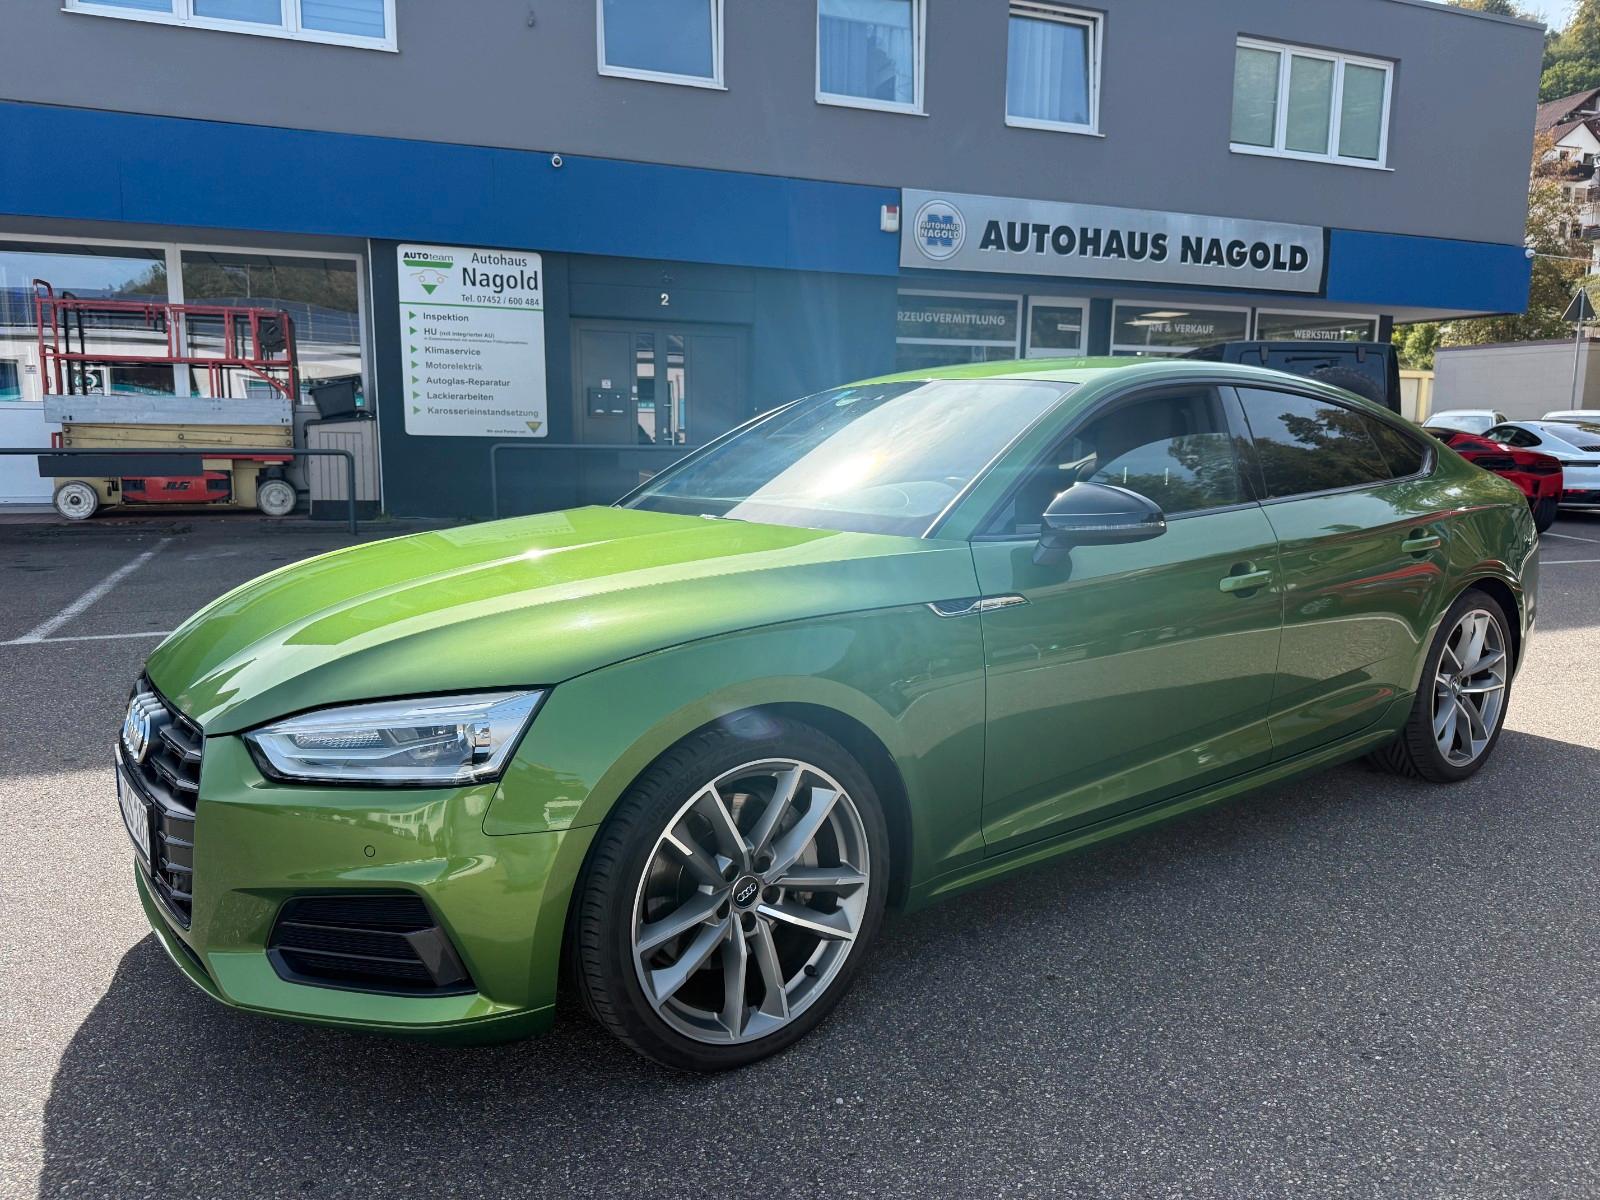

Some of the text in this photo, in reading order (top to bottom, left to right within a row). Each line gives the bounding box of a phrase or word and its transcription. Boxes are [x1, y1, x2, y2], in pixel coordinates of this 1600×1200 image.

[920, 221, 960, 231] AUTOHAUS
[920, 228, 960, 239] NAGOLD
[979, 220, 1309, 272] AUTOHAUS NAGOLD
[471, 252, 528, 267] Autohaus
[462, 267, 538, 294] Nagold
[461, 294, 475, 303] Tel.
[476, 295, 501, 304] 07452
[508, 297, 523, 306] 600
[525, 298, 540, 307] 484
[660, 292, 670, 306] 2
[423, 312, 469, 322] Inspektion
[897, 311, 1005, 327] RZEUGVERMITTLUNG
[424, 327, 437, 336] HU
[1174, 323, 1215, 335] VERKAUF
[1294, 329, 1339, 341] WERKSTATT
[425, 346, 481, 356] Klimaservice
[425, 361, 483, 371] Motorelektrik
[426, 376, 511, 387] Autoglas-Reparatur
[427, 391, 494, 401] Lackierarbeiten
[427, 406, 539, 418] Karosserieinstandsetzung
